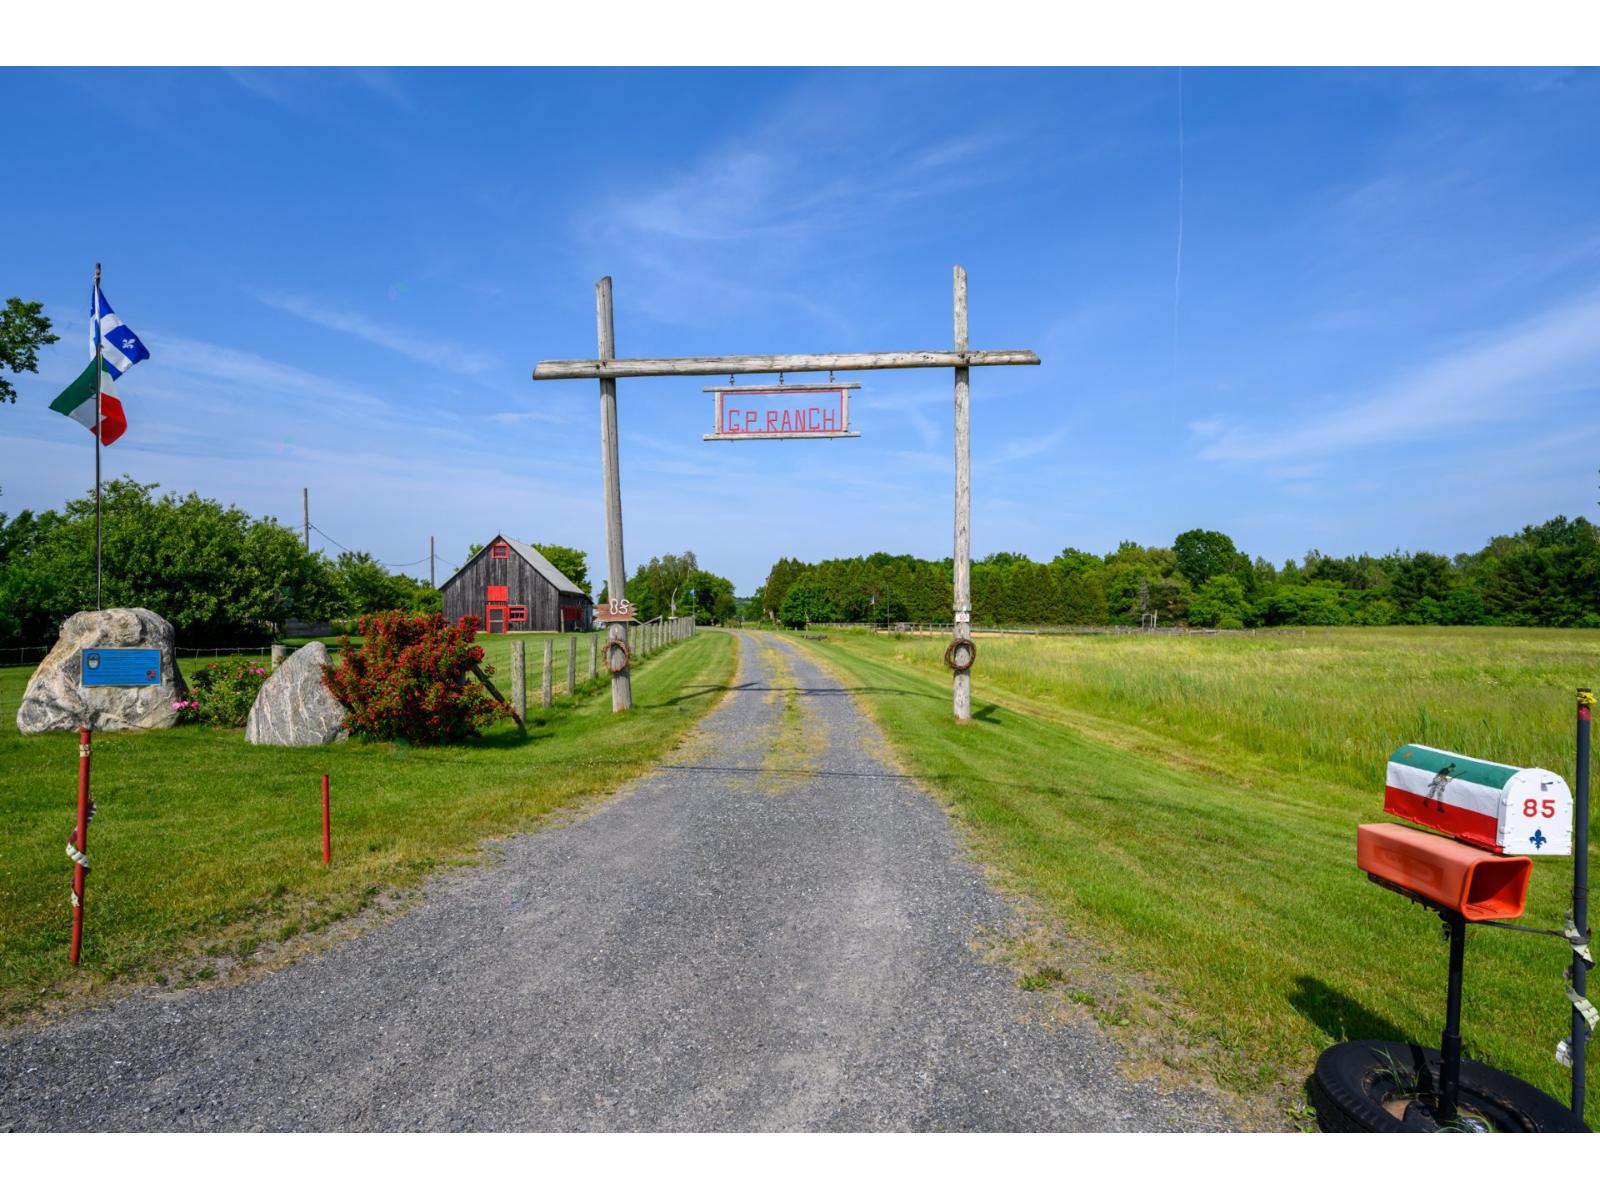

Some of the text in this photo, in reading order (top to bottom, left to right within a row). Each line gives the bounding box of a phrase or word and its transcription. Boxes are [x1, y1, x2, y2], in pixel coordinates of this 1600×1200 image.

[767, 408, 835, 432] RANCH
[610, 599, 630, 615] 85
[1523, 798, 1555, 818] 85
